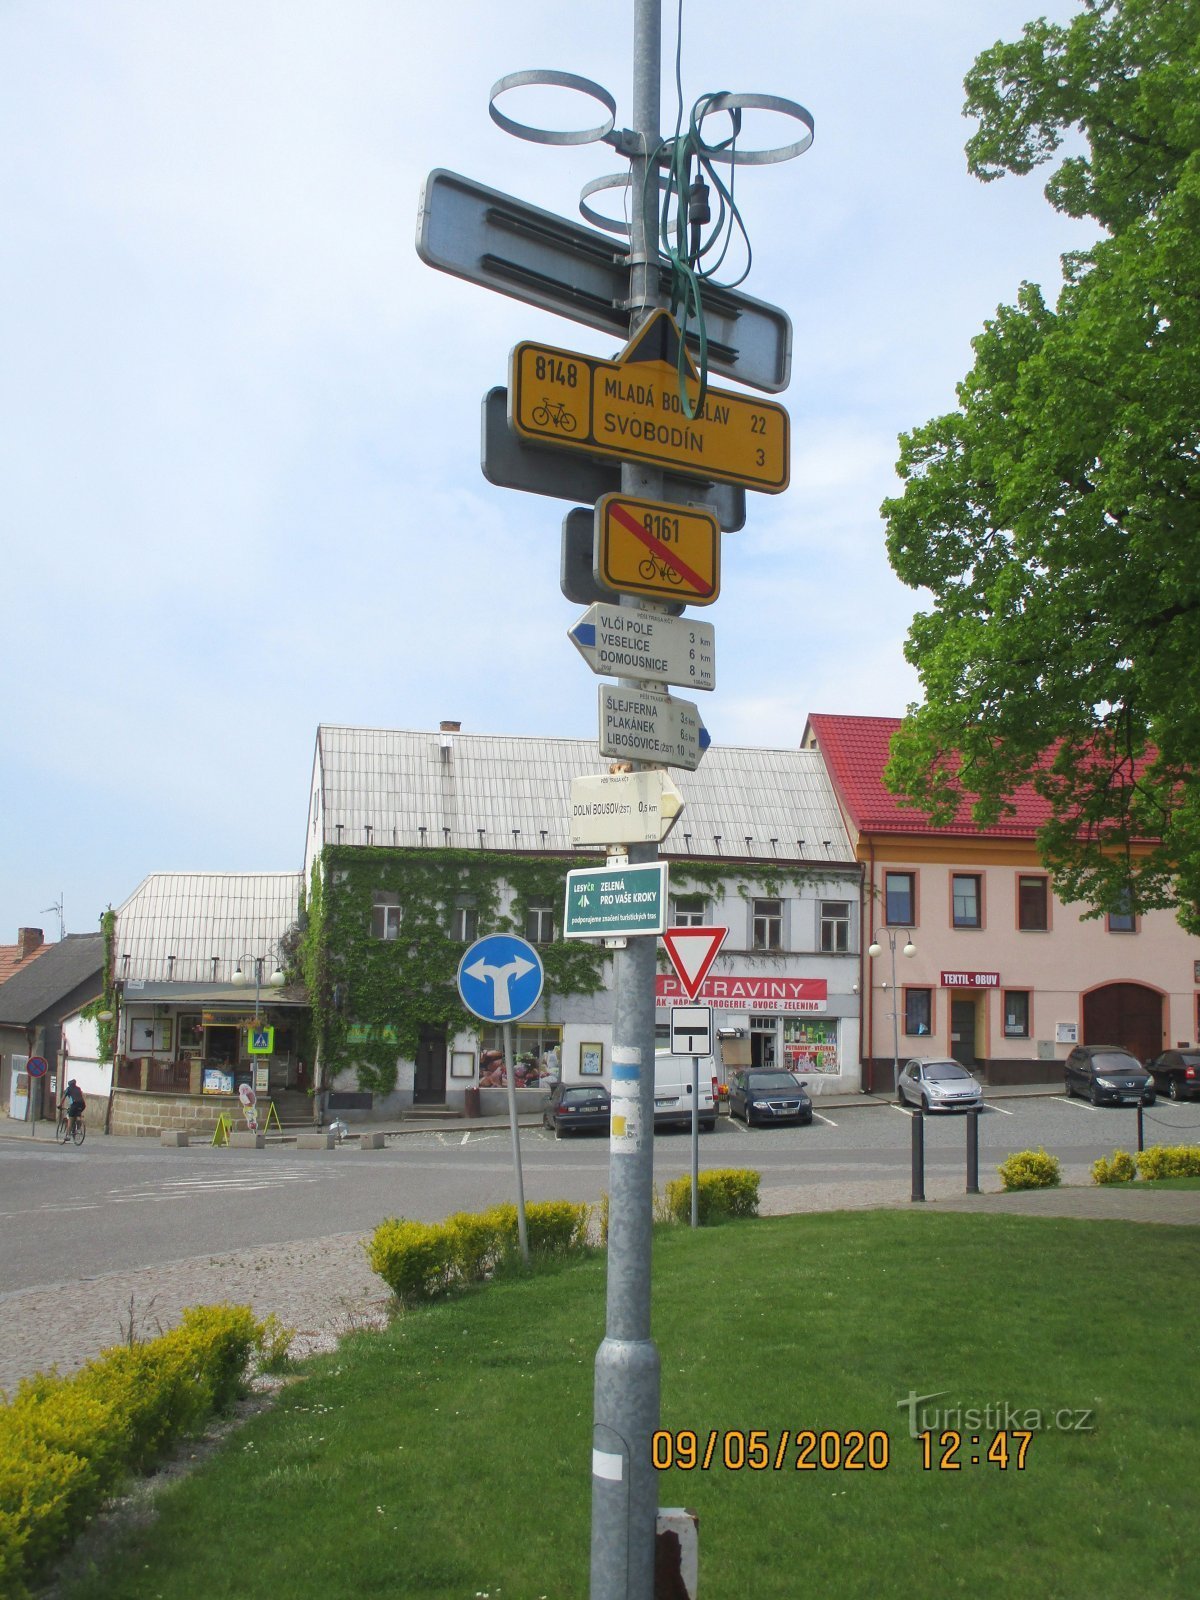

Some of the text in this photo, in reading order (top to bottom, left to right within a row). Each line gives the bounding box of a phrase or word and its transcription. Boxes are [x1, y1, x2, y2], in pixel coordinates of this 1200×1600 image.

[535, 356, 577, 388] 8148
[605, 378, 654, 407] MLADÁ
[751, 415, 766, 435] 22
[604, 413, 765, 467] SVOBODÍN 3
[643, 513, 679, 543] 8161
[601, 616, 711, 647] VLČÍ POLE 3 km
[601, 633, 711, 663] VESELICE 6 km
[600, 650, 668, 671] DOMOUSNICE
[689, 665, 695, 676] 8
[700, 671, 711, 679] km
[606, 696, 658, 717] ŠLEJFERNA
[607, 716, 655, 733] PLAKÁNEK
[607, 732, 660, 751] LIBOŠOVICE
[677, 744, 685, 756] 10
[573, 802, 592, 816] DOLNÍ
[593, 803, 619, 815] BOUSOV
[600, 879, 625, 892] ZELENÁ
[600, 892, 657, 905] PRO VAŠE KROKY
[944, 974, 997, 985] TEXTIL OBUV
[708, 1000, 746, 1009] DROGERIE
